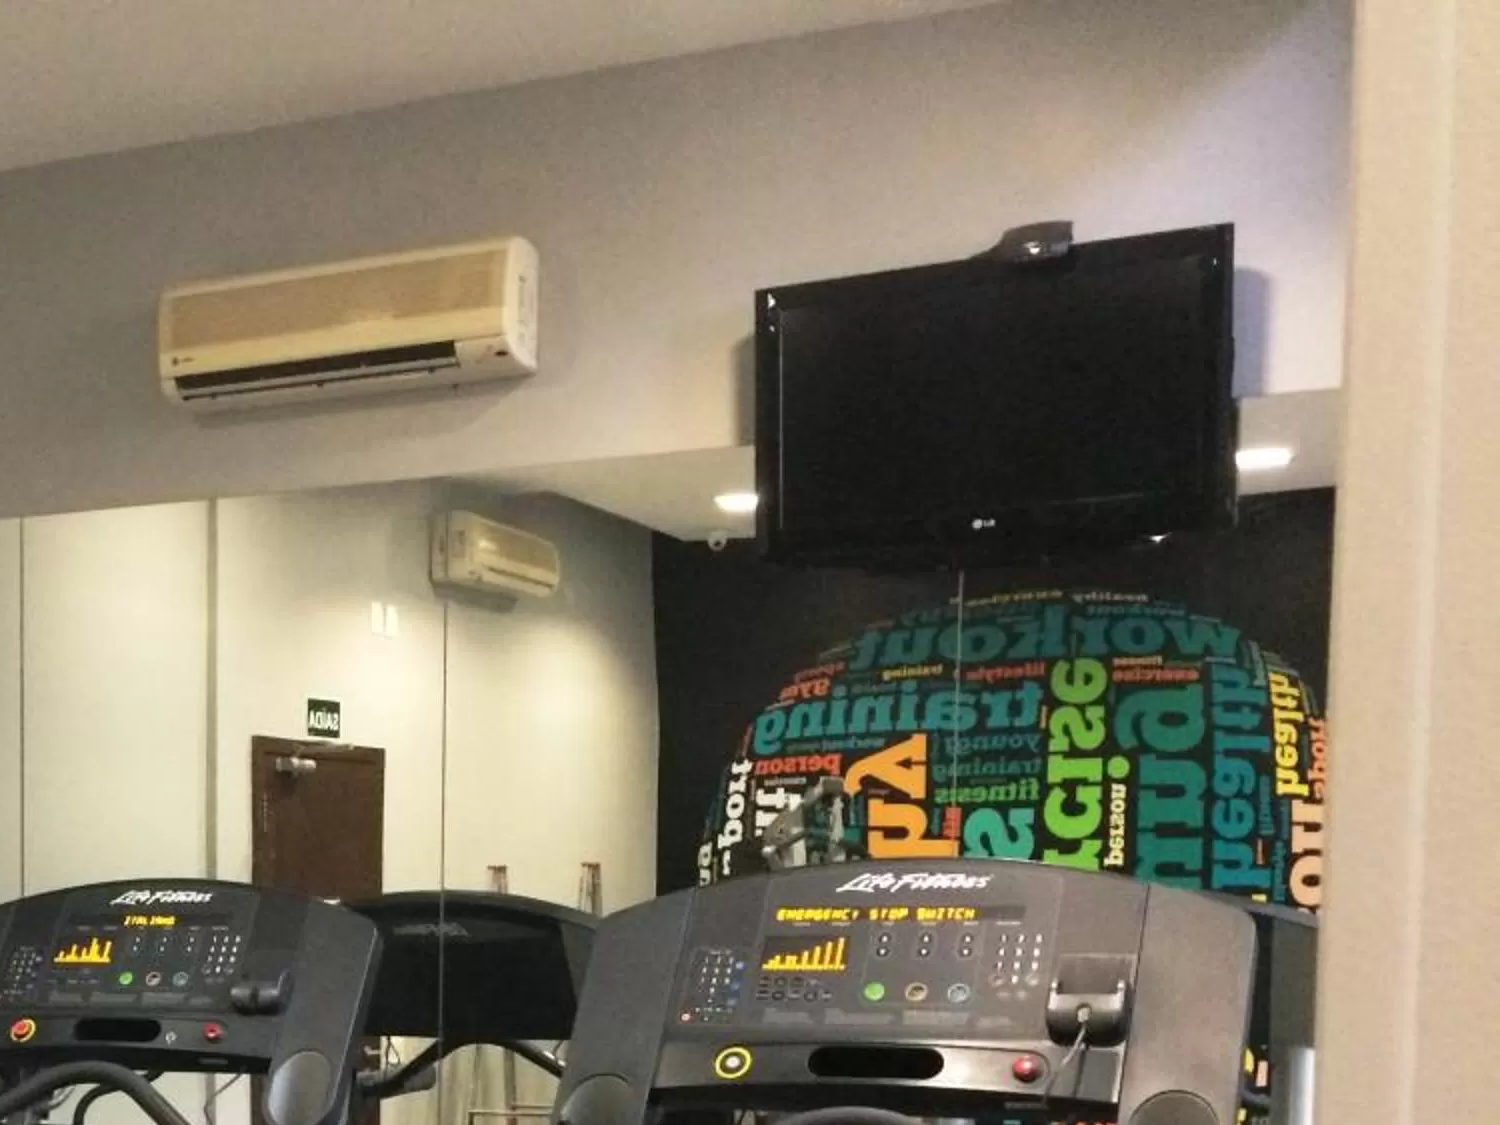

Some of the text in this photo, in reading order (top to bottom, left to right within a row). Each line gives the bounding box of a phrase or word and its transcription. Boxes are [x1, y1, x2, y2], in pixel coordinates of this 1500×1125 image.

[835, 873, 994, 893] Life Fitness
[776, 907, 976, 921] EMERGENCY STOP SWITCH
